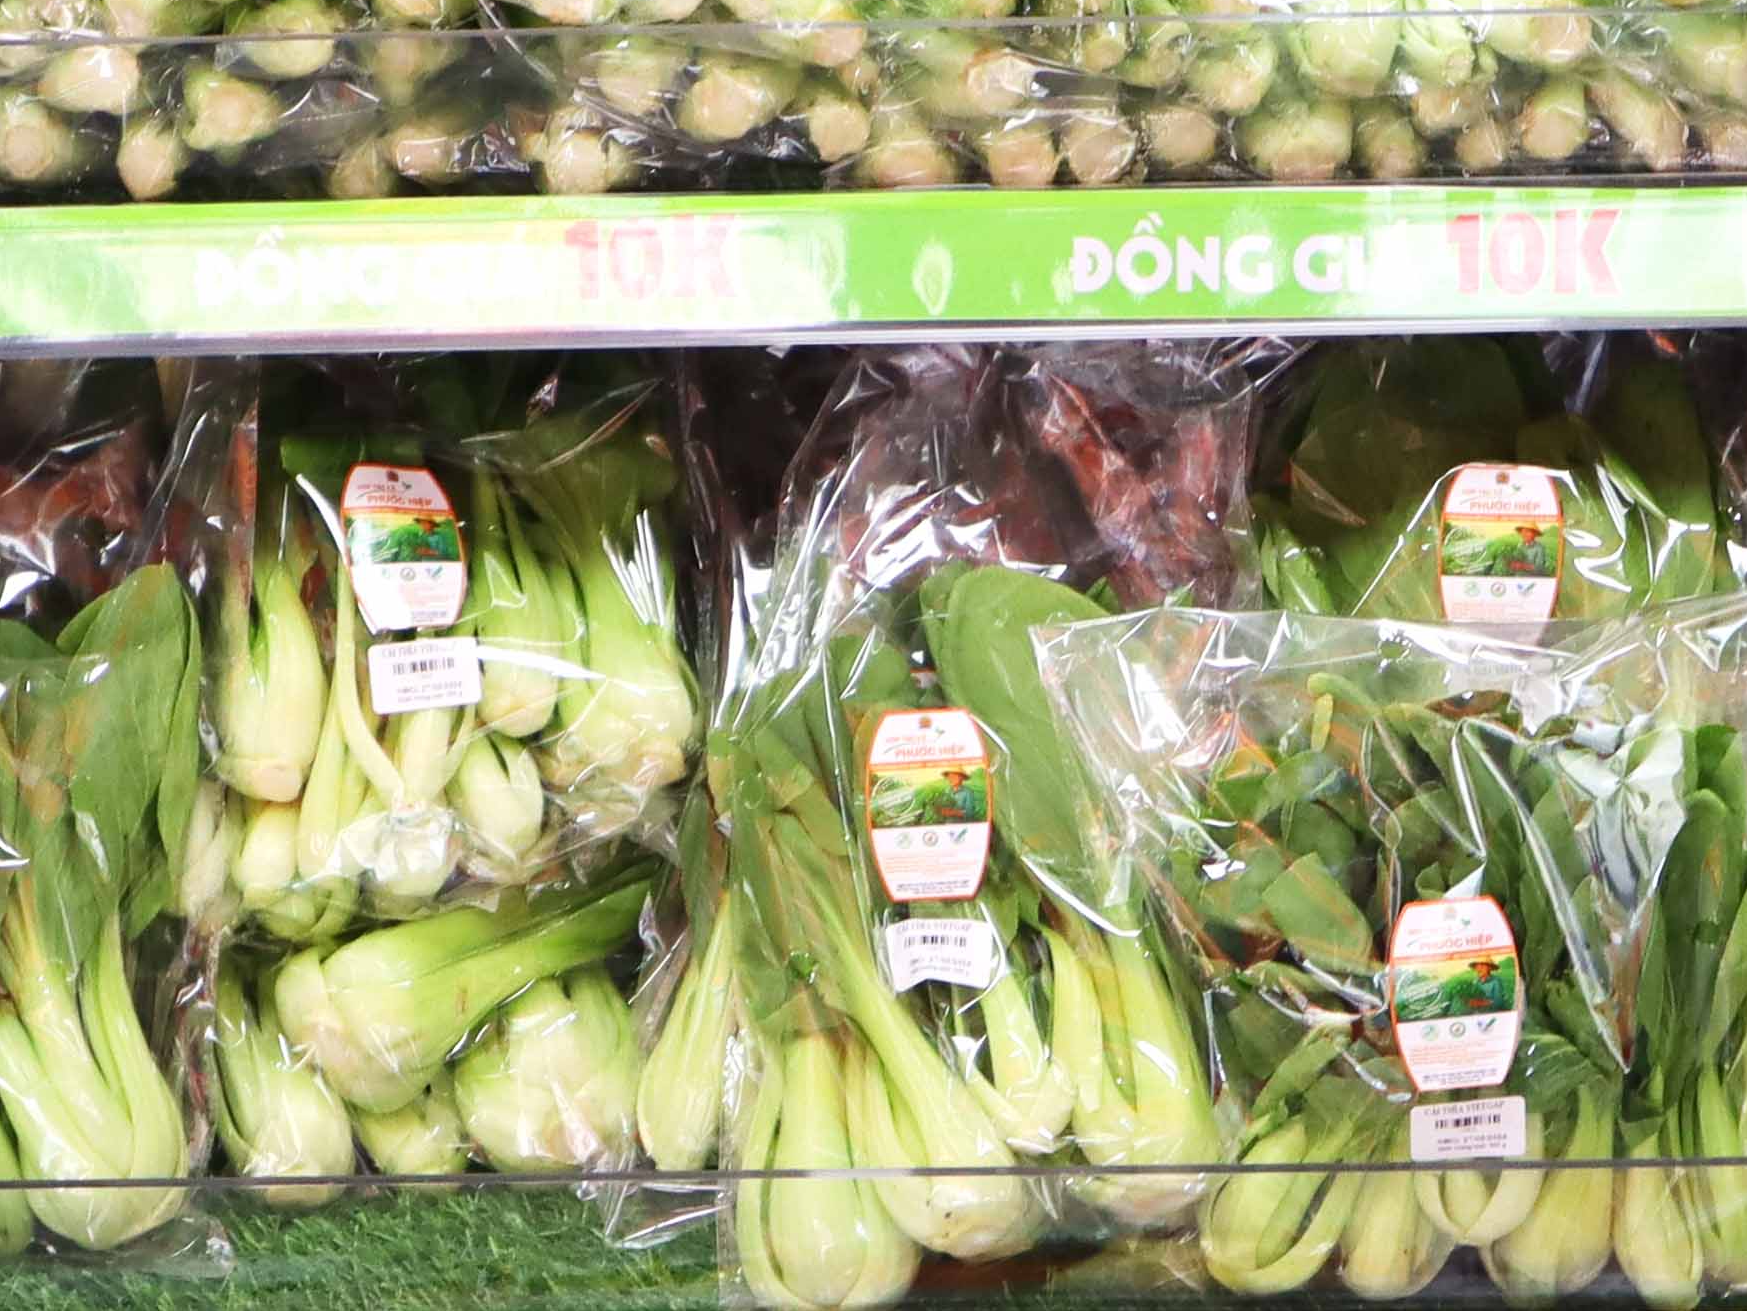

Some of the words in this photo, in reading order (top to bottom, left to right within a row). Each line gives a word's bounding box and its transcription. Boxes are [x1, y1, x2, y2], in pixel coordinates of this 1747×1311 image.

[565, 212, 740, 300] 10K
[1071, 212, 1275, 293] ĐỒNG
[1446, 207, 1622, 295] 10K
